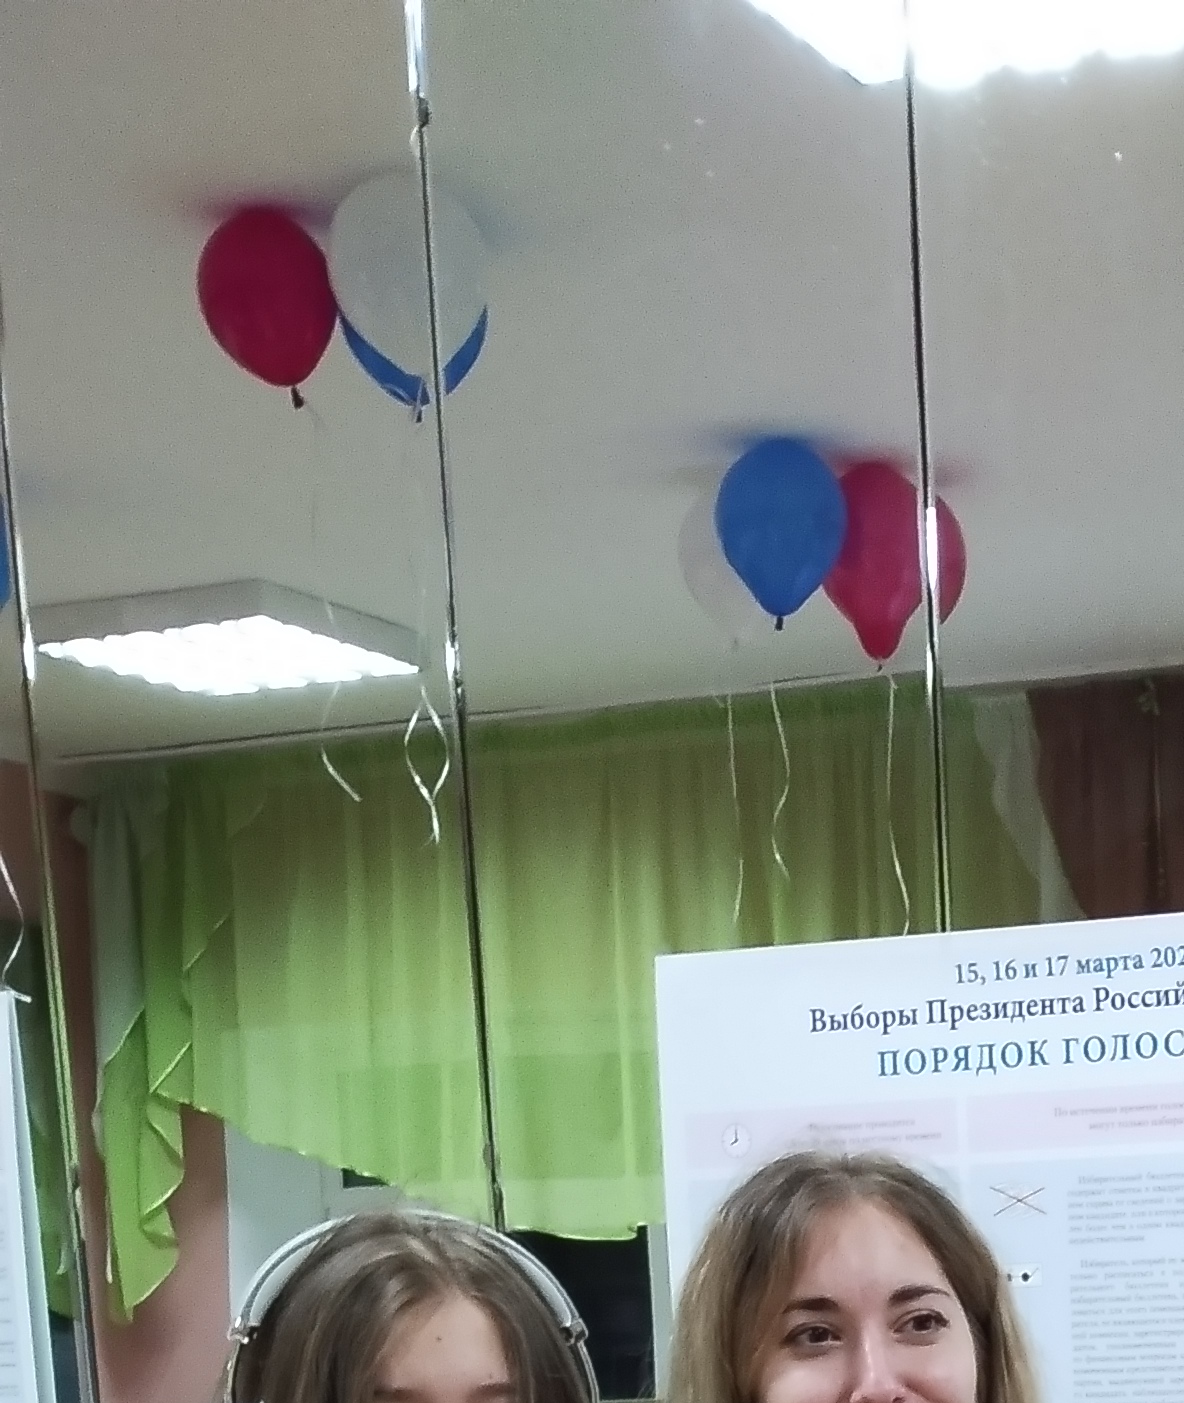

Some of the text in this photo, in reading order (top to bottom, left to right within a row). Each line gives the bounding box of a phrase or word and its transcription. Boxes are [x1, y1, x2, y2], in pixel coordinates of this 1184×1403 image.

[954, 962, 987, 987] 15,
[993, 958, 1018, 982] 16
[1023, 961, 1039, 979] и
[1045, 954, 1070, 978] 17
[1076, 953, 1145, 980] марта
[808, 1003, 919, 1036] Выборы
[925, 996, 1086, 1031] Президента
[877, 1039, 1050, 1077] ПОРЯДОК
